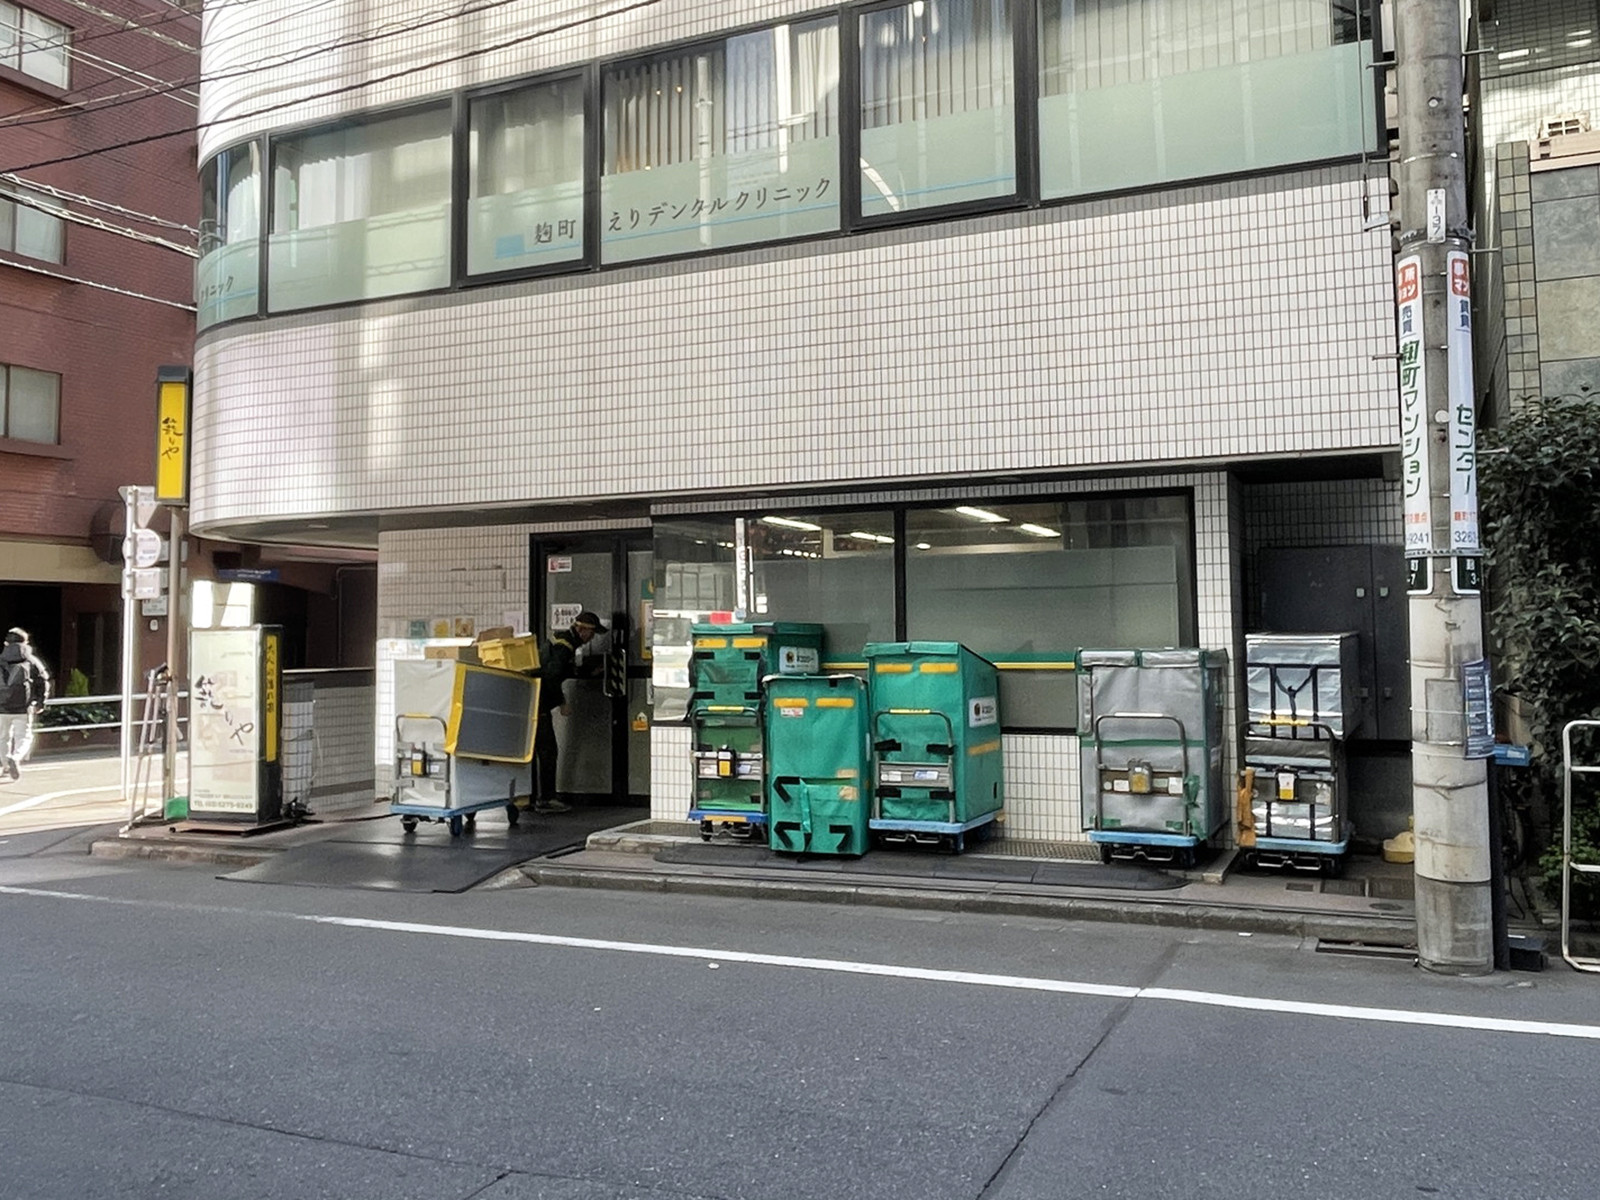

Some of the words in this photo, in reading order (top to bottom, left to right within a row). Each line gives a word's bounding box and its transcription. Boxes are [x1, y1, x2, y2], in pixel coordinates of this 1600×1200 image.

[608, 178, 831, 233] えりデンタルクリニック
[1455, 403, 1475, 495] センター
